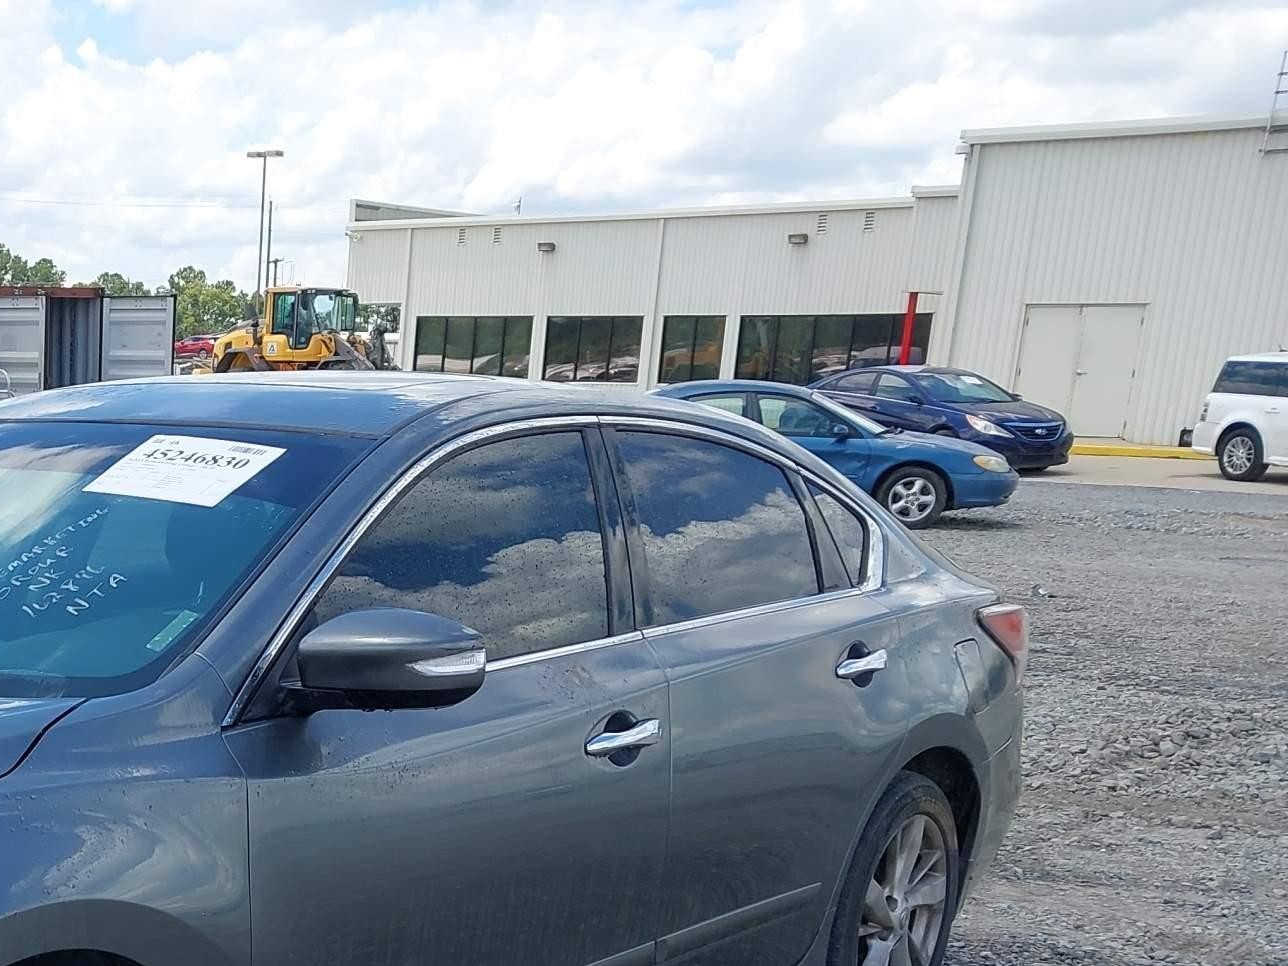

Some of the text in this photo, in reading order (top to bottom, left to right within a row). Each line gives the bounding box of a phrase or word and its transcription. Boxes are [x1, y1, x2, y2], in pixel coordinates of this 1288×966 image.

[143, 448, 251, 471] 45246830
[28, 567, 65, 593] NK
[65, 572, 128, 616] NTA
